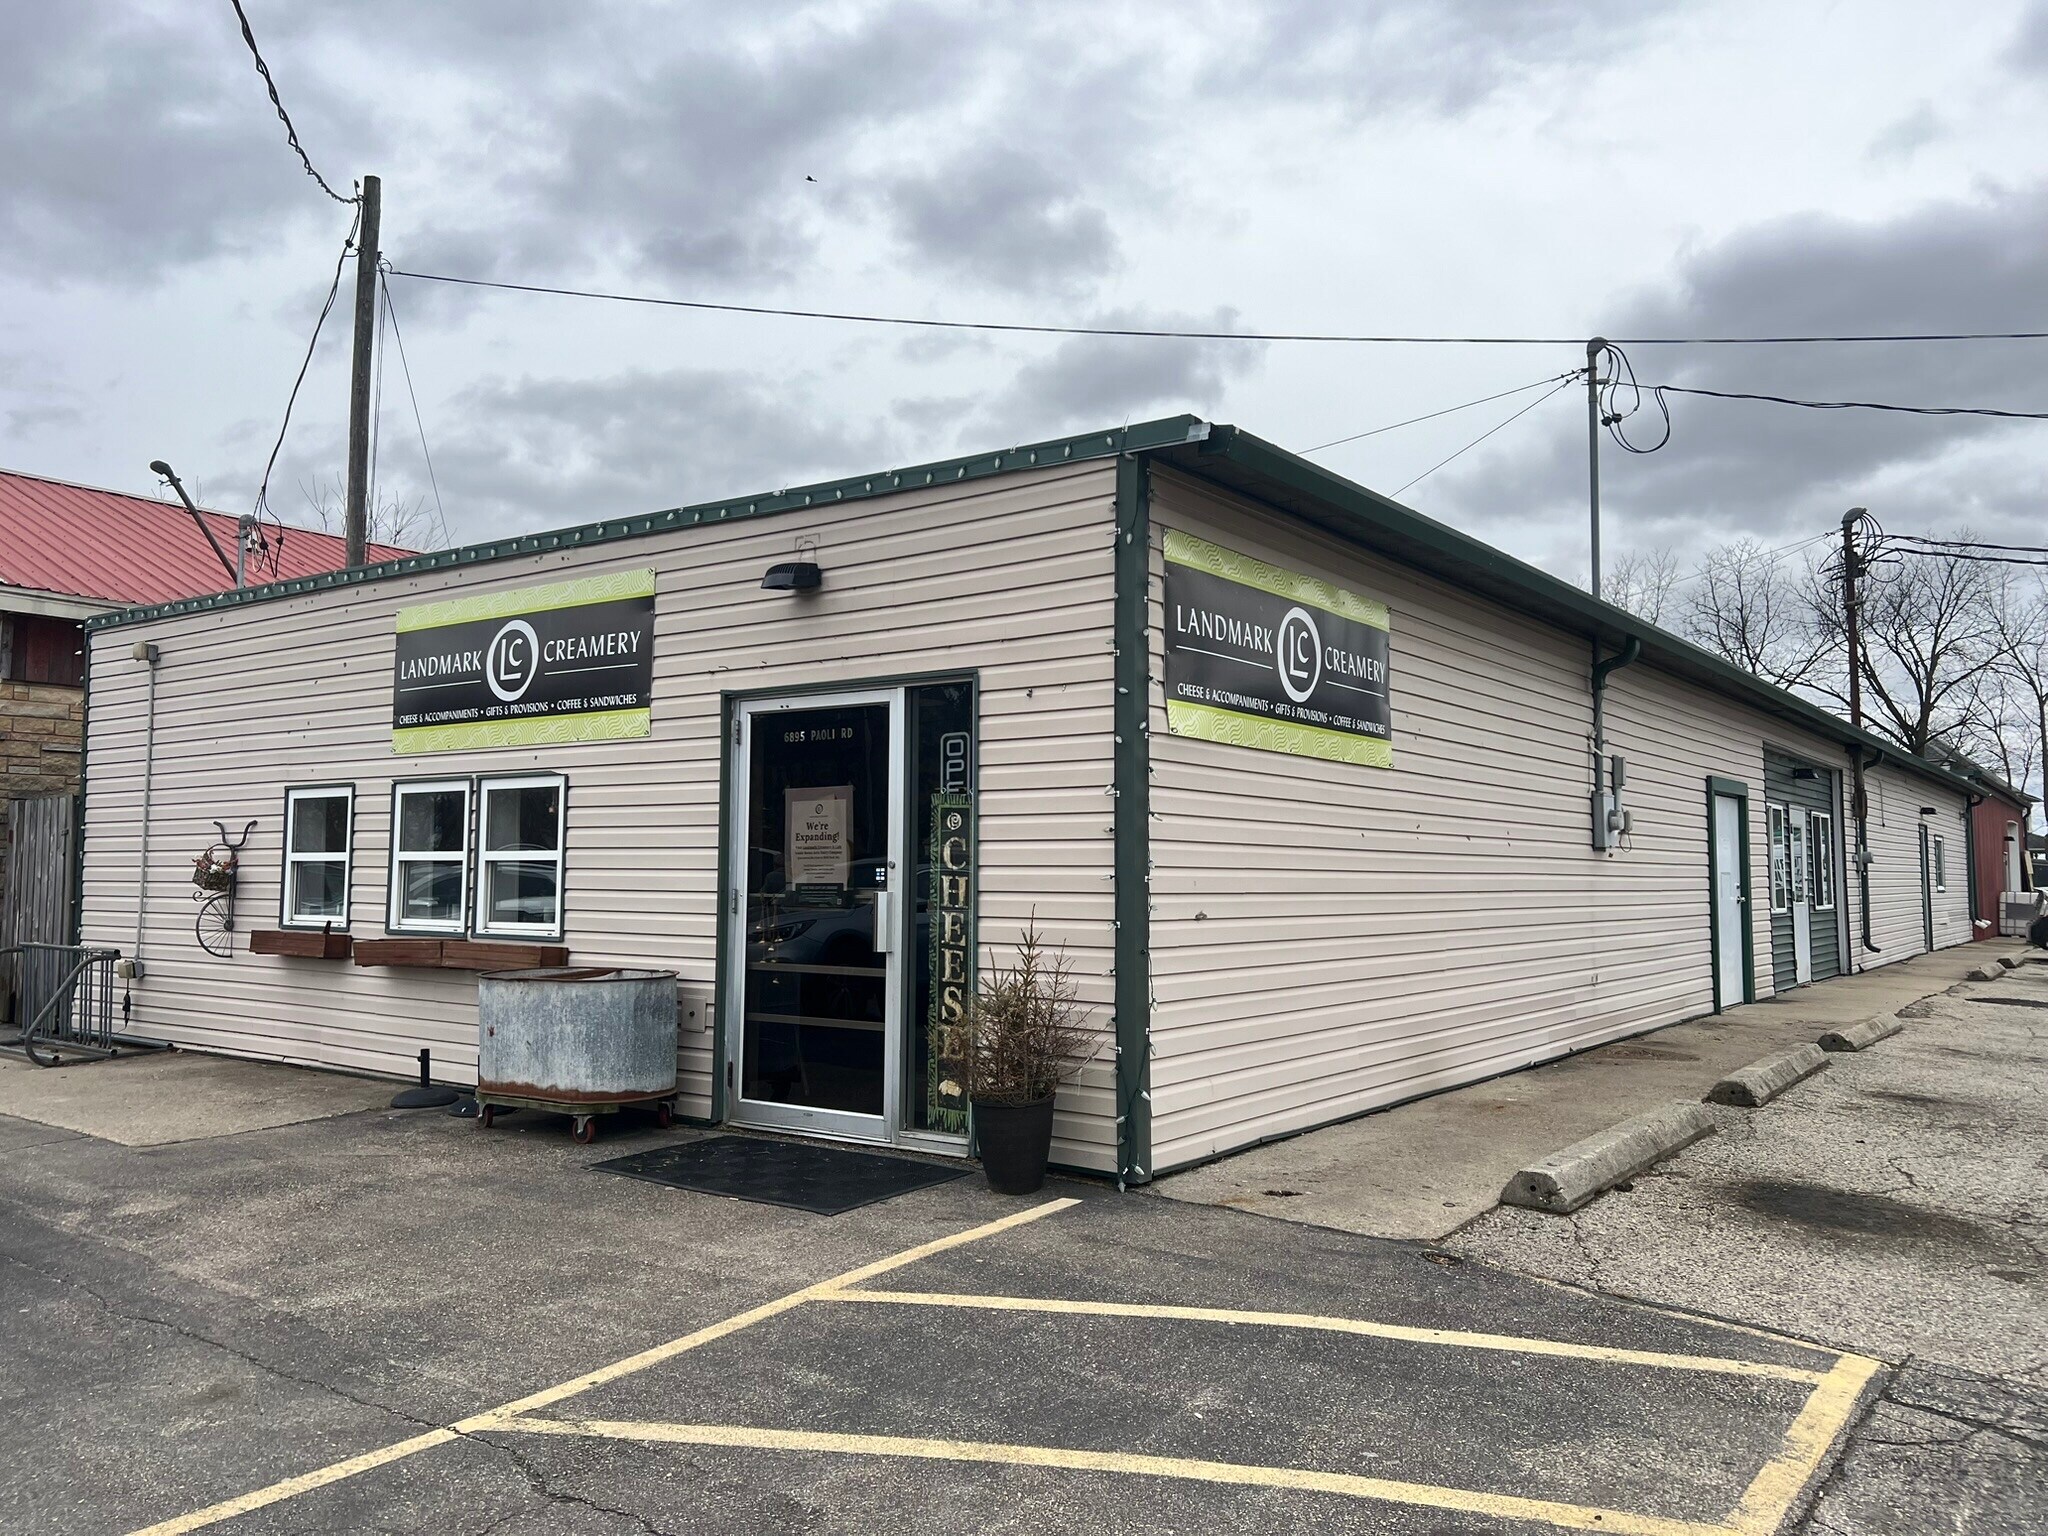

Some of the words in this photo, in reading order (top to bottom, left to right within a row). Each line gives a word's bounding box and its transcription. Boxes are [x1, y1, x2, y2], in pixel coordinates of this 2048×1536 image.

[401, 650, 482, 680] LANDMARK
[543, 630, 641, 662] CREAMERY
[1177, 605, 1273, 654] LANDMARK
[1325, 646, 1386, 684] CREAMERY
[399, 713, 418, 725] CHEESE
[424, 708, 479, 722] ACCOMPANIMENTS
[485, 705, 503, 717] GIFTS
[504, 705, 509, 715] &
[510, 701, 549, 715] PROVISIONS
[556, 698, 582, 711] COFFEE
[583, 698, 588, 708] &
[590, 693, 637, 708] SANDWICHES
[1177, 682, 1204, 699] CHEESE
[1205, 688, 1211, 700] &
[1211, 689, 1269, 712] ACCOMPANIMENTS
[1275, 703, 1291, 716] GIFTS
[1291, 706, 1296, 717] &
[1296, 707, 1328, 723] PROVISIONS
[1333, 714, 1352, 728] COFFEE
[1356, 719, 1386, 735] SANDWICHES
[784, 730, 805, 743] 6895
[811, 728, 835, 741] PAOLI
[841, 727, 853, 739] RD
[795, 831, 840, 843] Expanding!
[806, 820, 829, 831] We're
